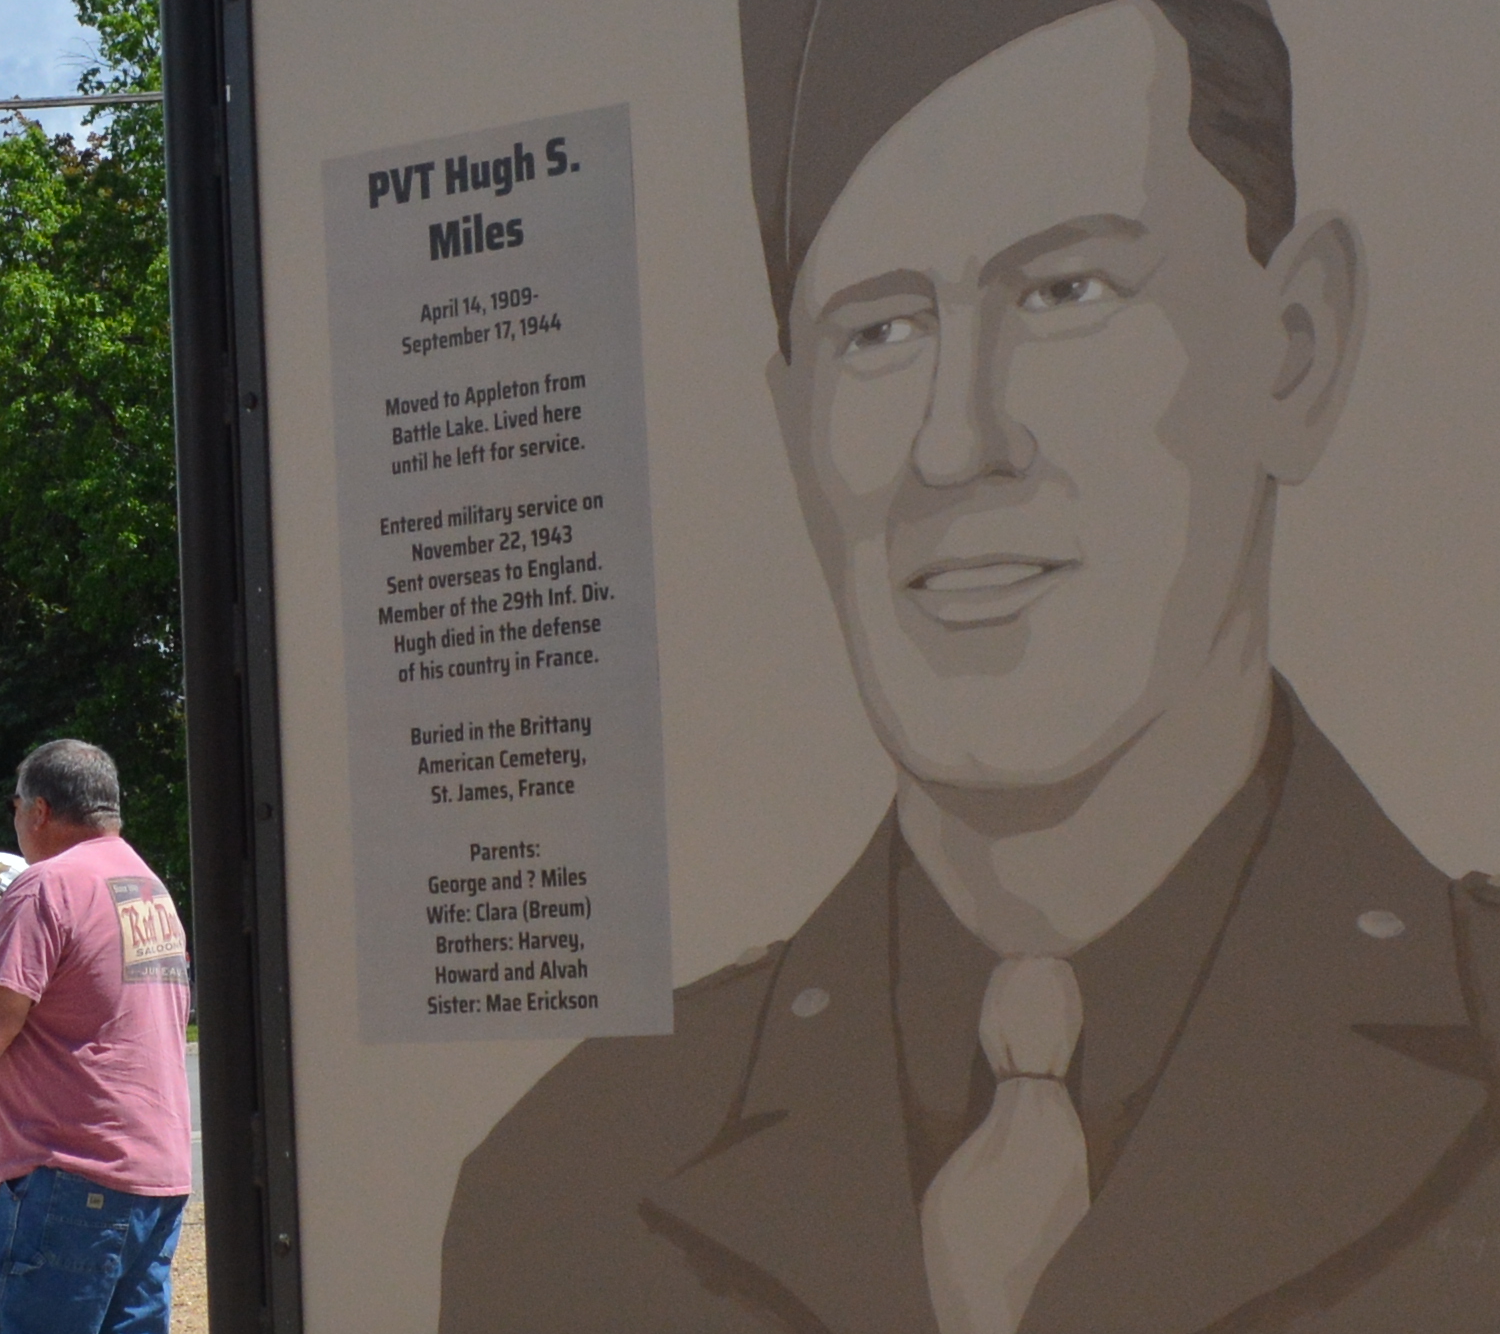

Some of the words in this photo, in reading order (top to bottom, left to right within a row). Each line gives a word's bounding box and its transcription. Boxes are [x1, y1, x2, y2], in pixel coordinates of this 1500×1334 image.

[368, 161, 435, 210] PVT
[444, 142, 536, 197] Hugh
[545, 136, 581, 177] S.
[428, 212, 524, 262] Miles
[420, 297, 459, 326] April
[462, 295, 487, 316] 14,
[490, 286, 539, 311] 1909-
[401, 325, 491, 357] September
[494, 319, 516, 342] 17,
[519, 312, 562, 337] 1944
[385, 390, 440, 417] Moved
[442, 390, 460, 408] to
[464, 380, 540, 408] Appleton
[544, 373, 586, 394] from
[392, 421, 442, 446] Battle
[445, 415, 489, 438] Lake.
[493, 405, 538, 431] Lived
[542, 404, 582, 424] here
[391, 451, 428, 476] until
[432, 450, 452, 470] he
[456, 444, 486, 466] left
[489, 441, 515, 462] for
[519, 432, 585, 458] service.
[379, 509, 444, 536] Entered
[447, 504, 513, 528] military
[517, 494, 578, 519] service
[582, 494, 604, 511] on
[411, 535, 495, 562] November
[499, 530, 527, 552] 22,
[530, 524, 573, 548] 1943
[386, 573, 424, 595] Sent
[428, 567, 501, 590] overseas
[504, 563, 523, 581] to
[527, 550, 603, 581] England.
[378, 601, 446, 626] Member
[449, 596, 466, 618] of
[470, 594, 498, 615] the
[502, 588, 544, 612] 29th
[548, 584, 577, 607] Inf.
[581, 581, 615, 603] Div.
[393, 630, 437, 657] Hugh
[440, 625, 476, 649] died
[479, 624, 495, 644] in
[498, 621, 528, 642] the
[531, 616, 602, 639] defense
[398, 661, 416, 683] of
[419, 660, 444, 681] his
[447, 655, 511, 678] country
[514, 650, 531, 671] in
[535, 649, 599, 669] France.
[410, 722, 464, 746] Buried
[468, 721, 484, 741] in
[487, 718, 516, 739] the
[520, 714, 592, 737] Brittany
[417, 751, 495, 775] American
[499, 747, 587, 769] Cemetery,
[430, 785, 453, 805] St.
[457, 783, 514, 802] James,
[518, 778, 575, 798] France
[469, 840, 541, 862] Parents:
[427, 875, 487, 898] George
[491, 869, 523, 891] and
[526, 869, 536, 889] ?
[540, 866, 587, 888] Miles
[425, 903, 471, 925] Wife:
[475, 901, 518, 923] Clara
[522, 896, 592, 923] (Breum)
[435, 932, 514, 955] Brothers:
[518, 931, 585, 954] Harvey,
[434, 961, 500, 985] Howard
[503, 960, 535, 982] and
[539, 958, 588, 980] Alvah
[427, 994, 481, 1015] Sister:
[485, 993, 522, 1013] Mae
[526, 989, 599, 1012] Erickson
